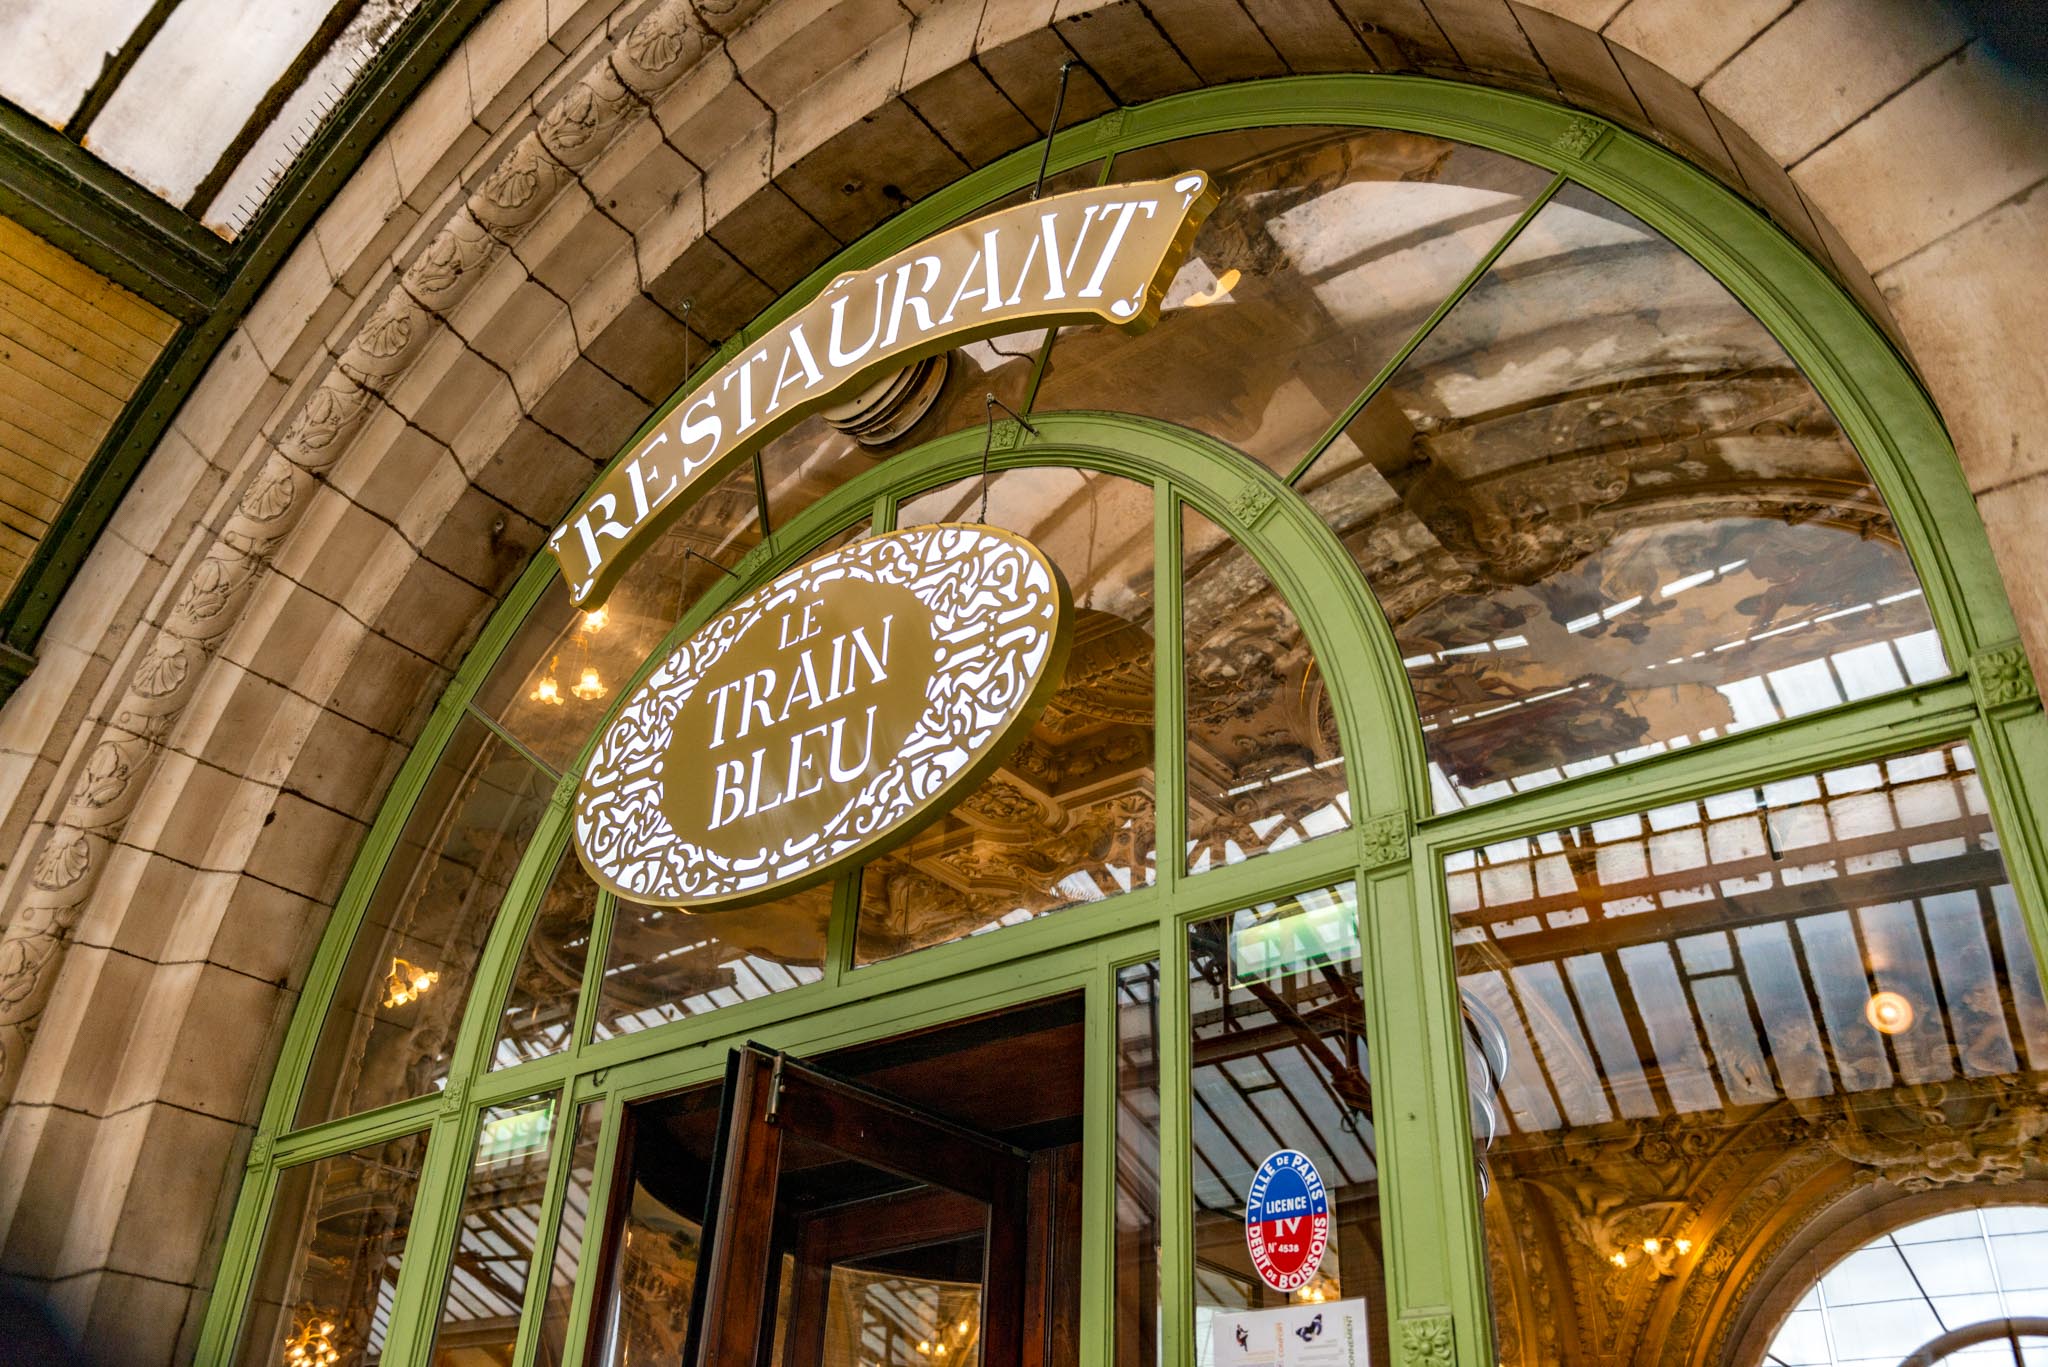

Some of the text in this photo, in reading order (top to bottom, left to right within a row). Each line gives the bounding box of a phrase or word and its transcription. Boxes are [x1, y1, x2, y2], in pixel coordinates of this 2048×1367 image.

[777, 599, 824, 651] LE
[706, 614, 894, 750] TRAIN
[707, 705, 878, 831] BLEU
[1249, 1153, 1324, 1210] VILLE DE PARIS
[1265, 1196, 1307, 1215] LICENCE
[1248, 1216, 1327, 1290] DEBIT DE BOISSONS
[1274, 1216, 1303, 1238] IV
